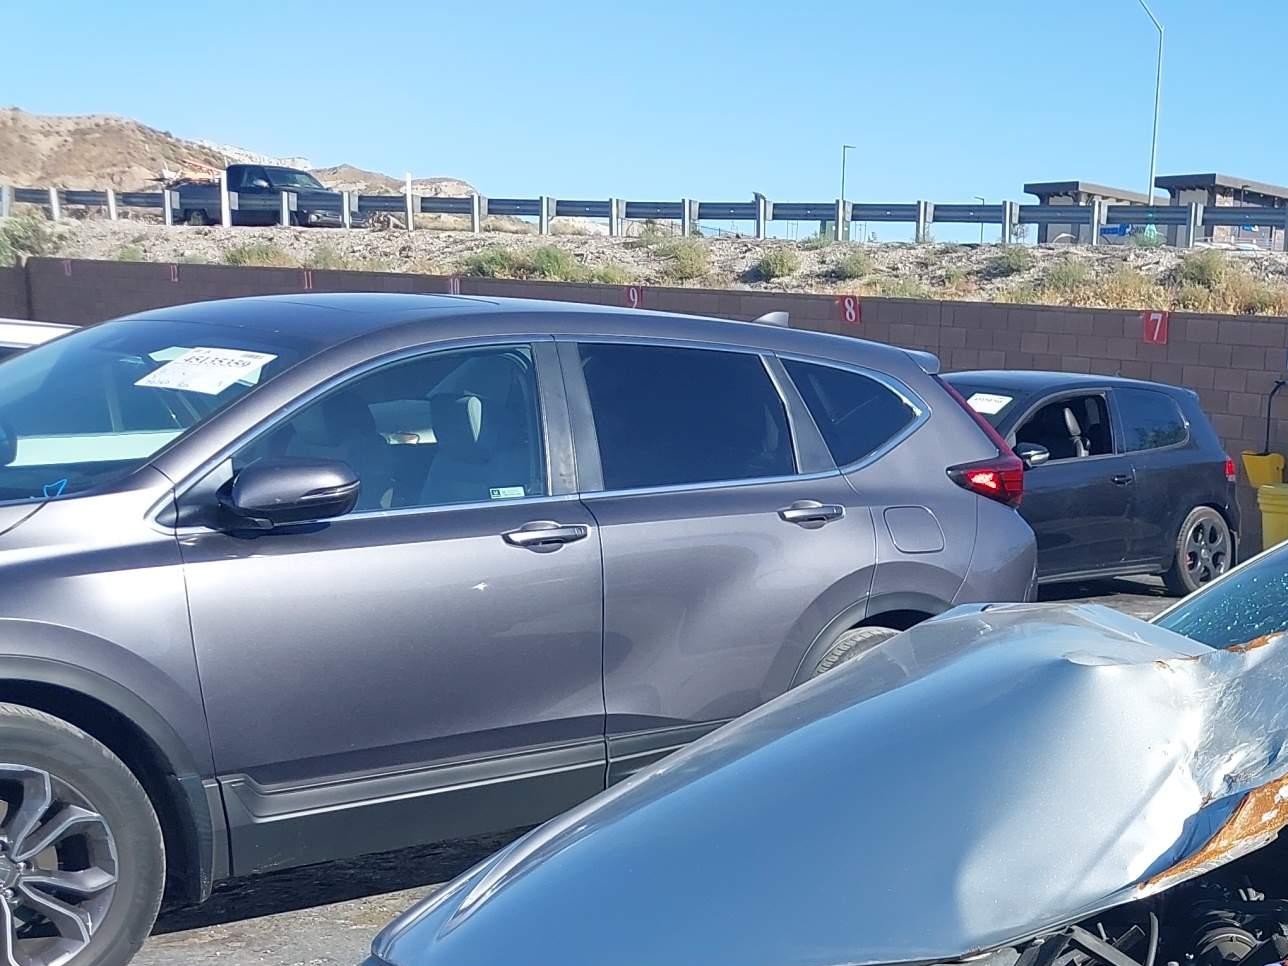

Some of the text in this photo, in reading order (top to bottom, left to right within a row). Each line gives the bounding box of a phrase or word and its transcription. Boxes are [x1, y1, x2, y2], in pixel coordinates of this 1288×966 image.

[630, 288, 638, 308] 9
[844, 298, 857, 322] 8
[1150, 313, 1163, 341] 7
